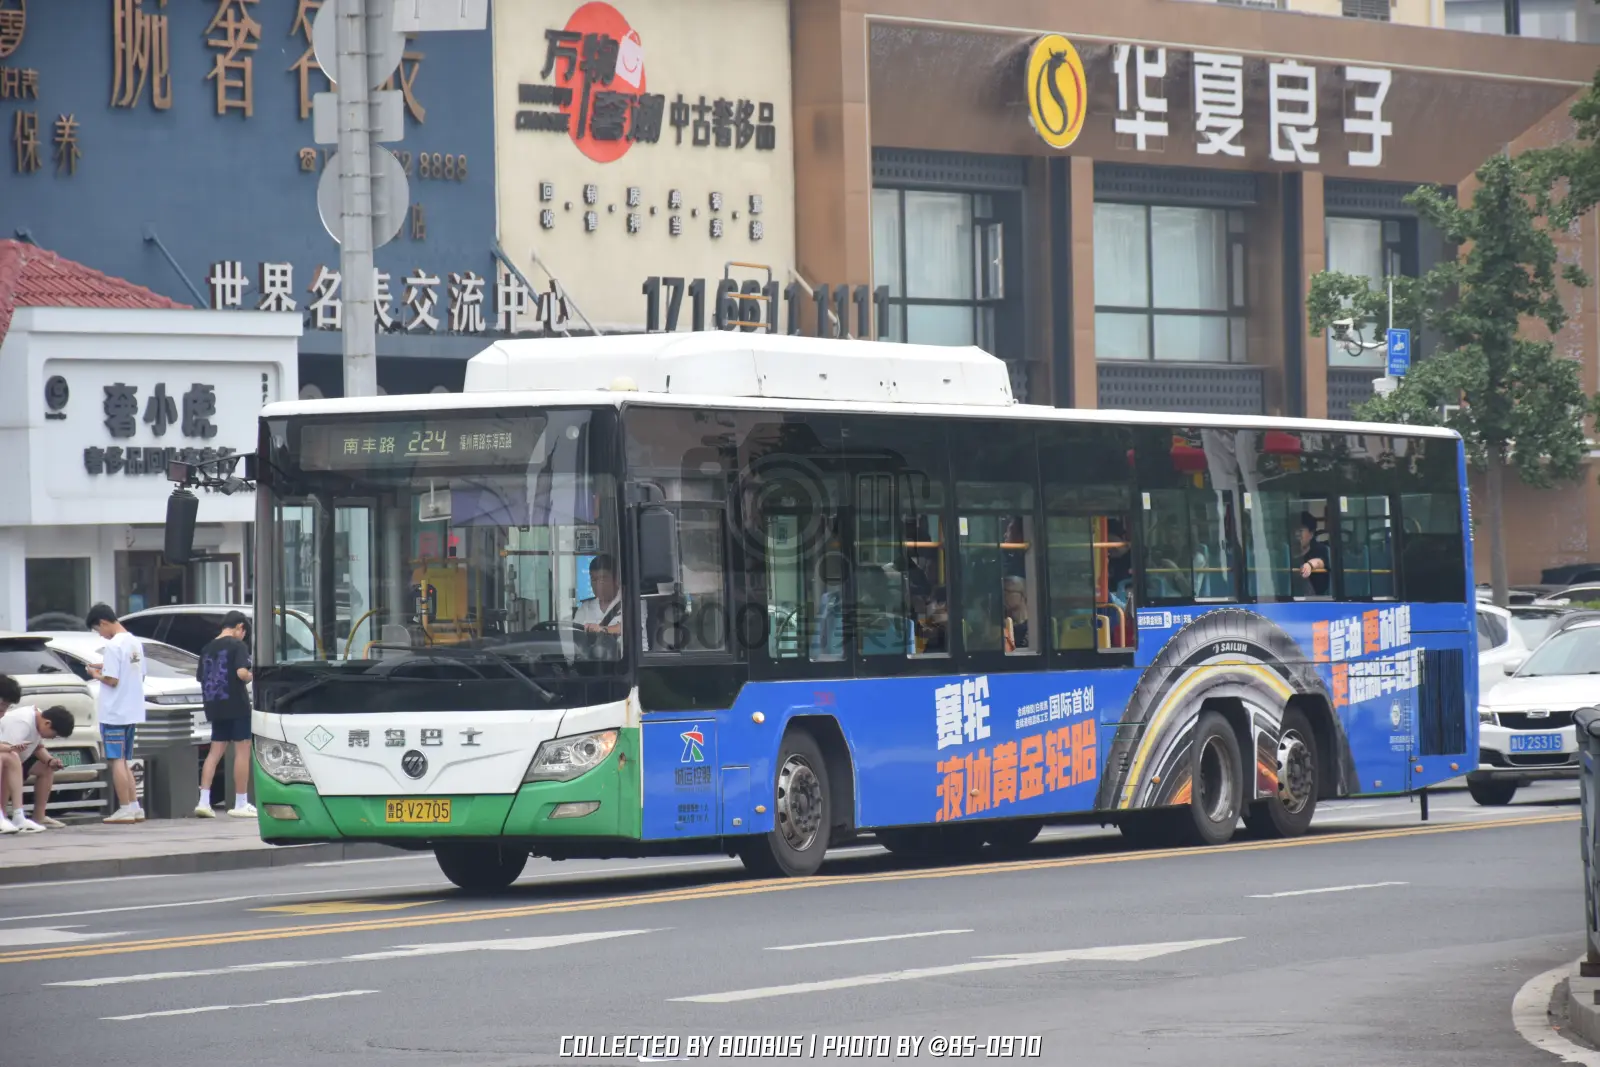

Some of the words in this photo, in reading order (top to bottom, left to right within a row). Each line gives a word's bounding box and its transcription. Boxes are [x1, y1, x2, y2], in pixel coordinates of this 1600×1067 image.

[670, 93, 776, 151] 中古奢侈品
[1114, 44, 1392, 167] 华夏良子
[15, 110, 82, 176] 保养
[540, 182, 554, 229] 回收
[627, 187, 641, 234] 质押
[668, 189, 682, 236] 典当
[208, 260, 570, 333] 世界名表交流中心
[103, 382, 218, 438] 奢小虎
[343, 436, 395, 454] 南丰路
[408, 430, 447, 451] 224
[1220, 642, 1248, 653] SAILUN
[1312, 605, 1411, 666] 更省油更耐磨
[935, 676, 990, 749] 赛轮
[1049, 685, 1094, 721] 国际首创
[309, 733, 329, 743] CNG
[348, 727, 483, 747] 青岛巴士
[935, 719, 1096, 823] 液体黄金轮胎
